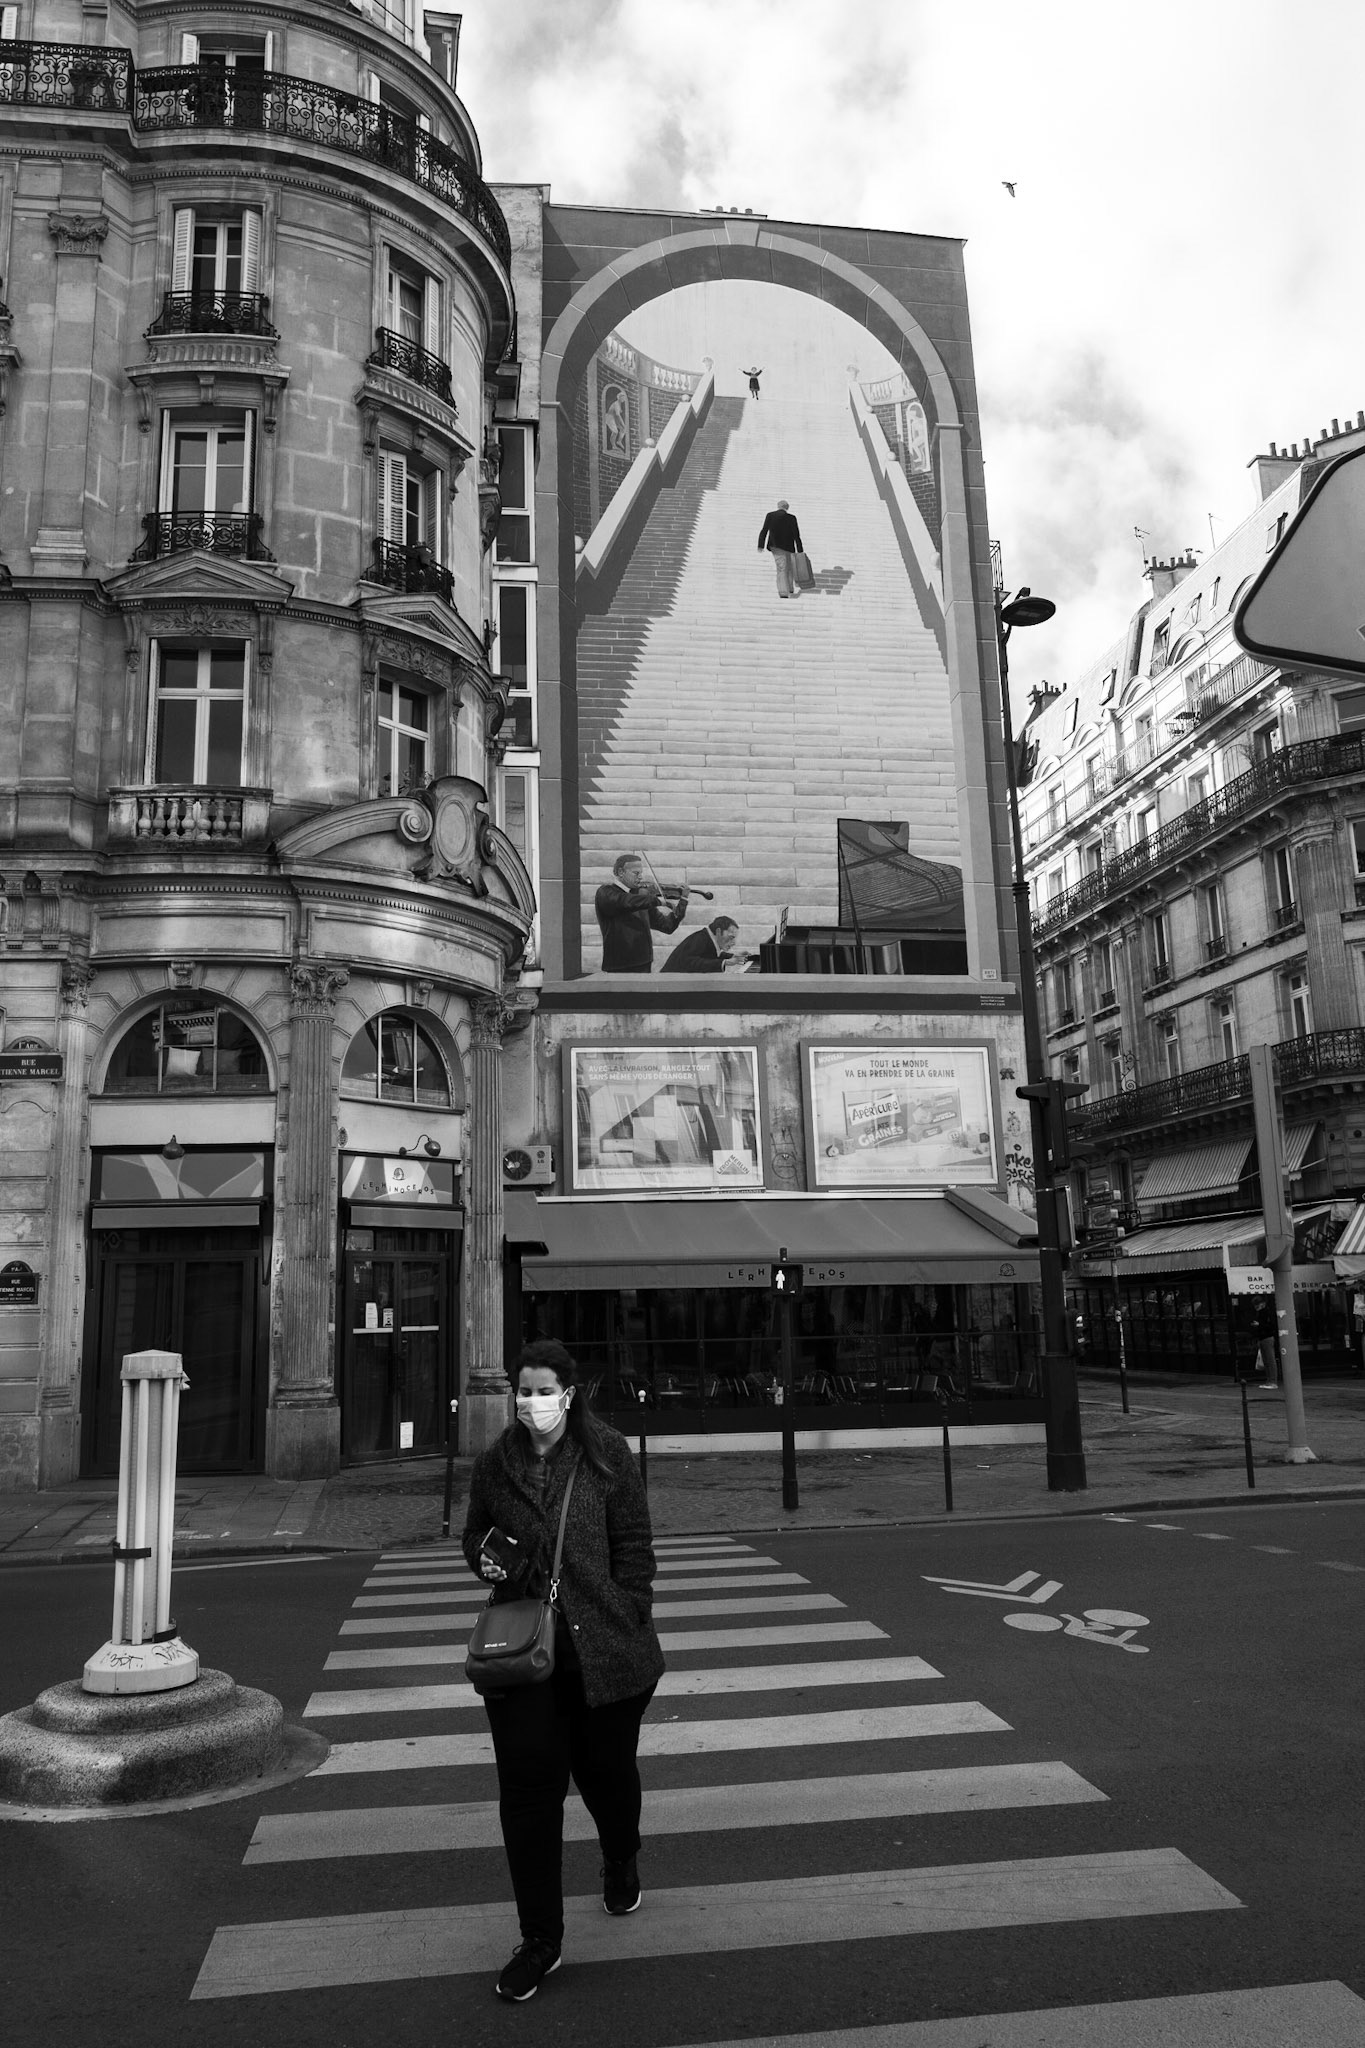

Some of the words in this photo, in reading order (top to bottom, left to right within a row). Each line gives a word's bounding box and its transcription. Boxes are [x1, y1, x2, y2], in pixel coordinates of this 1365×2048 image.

[870, 1060, 889, 1068] TOUT
[892, 1060, 900, 1068] LE
[902, 1059, 929, 1068] MONDE
[0, 1068, 27, 1076] TIENNE
[30, 1068, 60, 1076] MARCEL
[588, 1065, 607, 1073] AVEC
[661, 1064, 691, 1072] RANGEZ
[692, 1064, 711, 1072] TOUT
[588, 1073, 608, 1081] SANS
[845, 1069, 854, 1078] VA
[857, 1069, 867, 1078] EN
[869, 1069, 902, 1078] PRENDRE
[905, 1069, 914, 1078] DE
[917, 1069, 925, 1078] LA
[928, 1069, 955, 1078] GRAINE
[858, 1125, 904, 1146] GRAINES
[716, 1158, 731, 1175] LEROY
[730, 1154, 750, 1175] MERLIN
